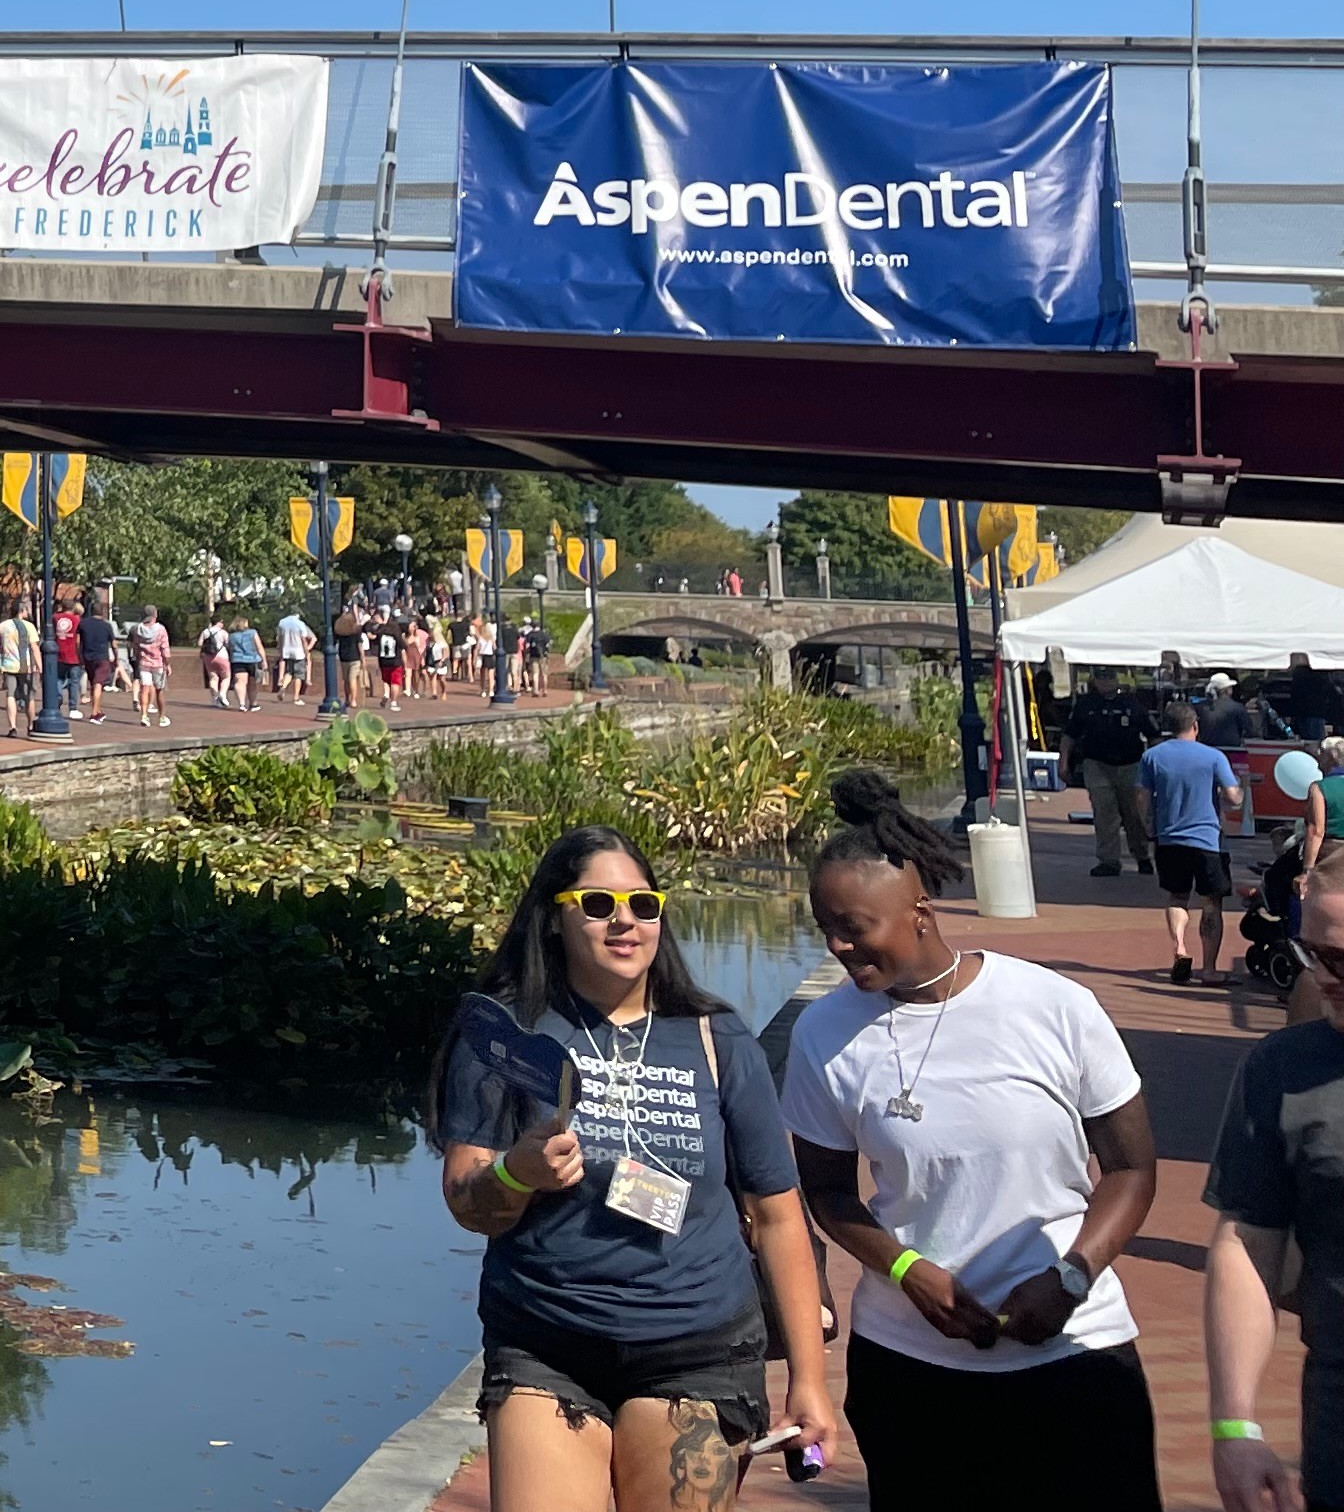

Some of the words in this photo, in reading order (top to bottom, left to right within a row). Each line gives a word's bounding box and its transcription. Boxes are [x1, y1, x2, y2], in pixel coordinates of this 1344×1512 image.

[533, 162, 1028, 235] AspenDental
[14, 206, 204, 238] FREDERICK
[659, 247, 909, 268] www.aspendenl.com
[581, 1078, 697, 1109] spenDental
